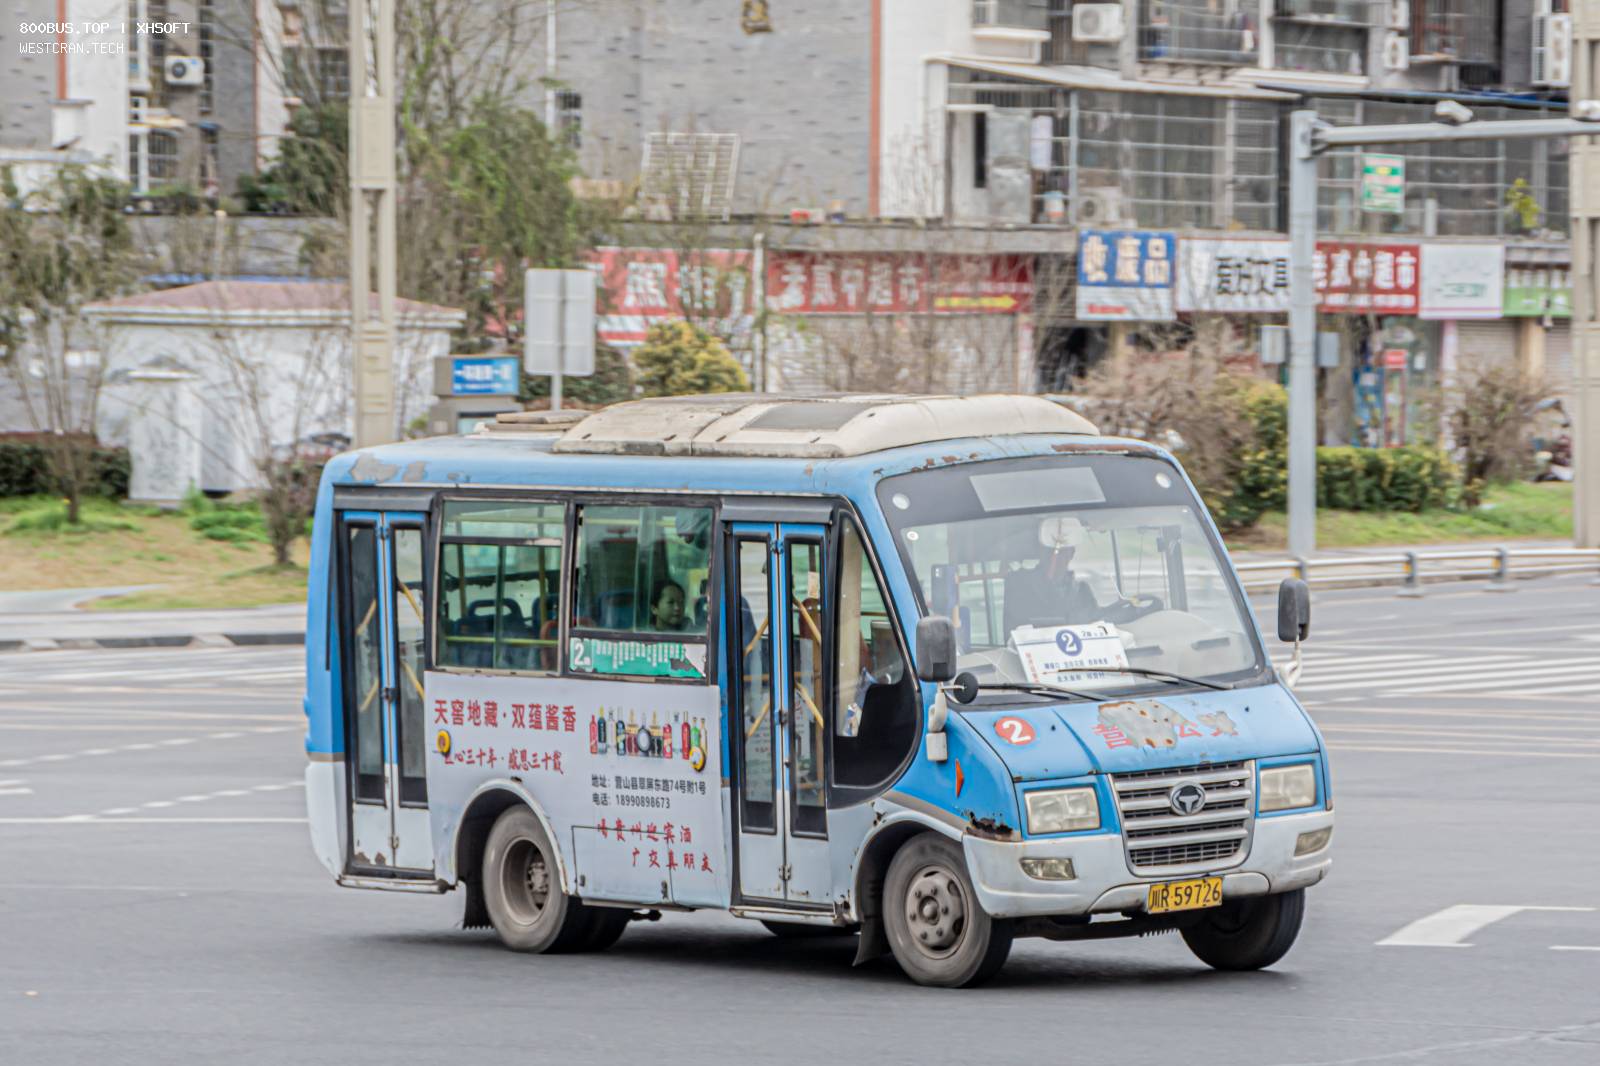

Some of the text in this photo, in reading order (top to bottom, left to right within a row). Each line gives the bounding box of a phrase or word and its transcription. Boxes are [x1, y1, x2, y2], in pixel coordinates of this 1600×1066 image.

[1061, 632, 1078, 652] 2
[434, 699, 577, 732] 天窖地藏·双蕴酱香
[1002, 719, 1031, 744] 2
[632, 847, 714, 874] 广交真朋友
